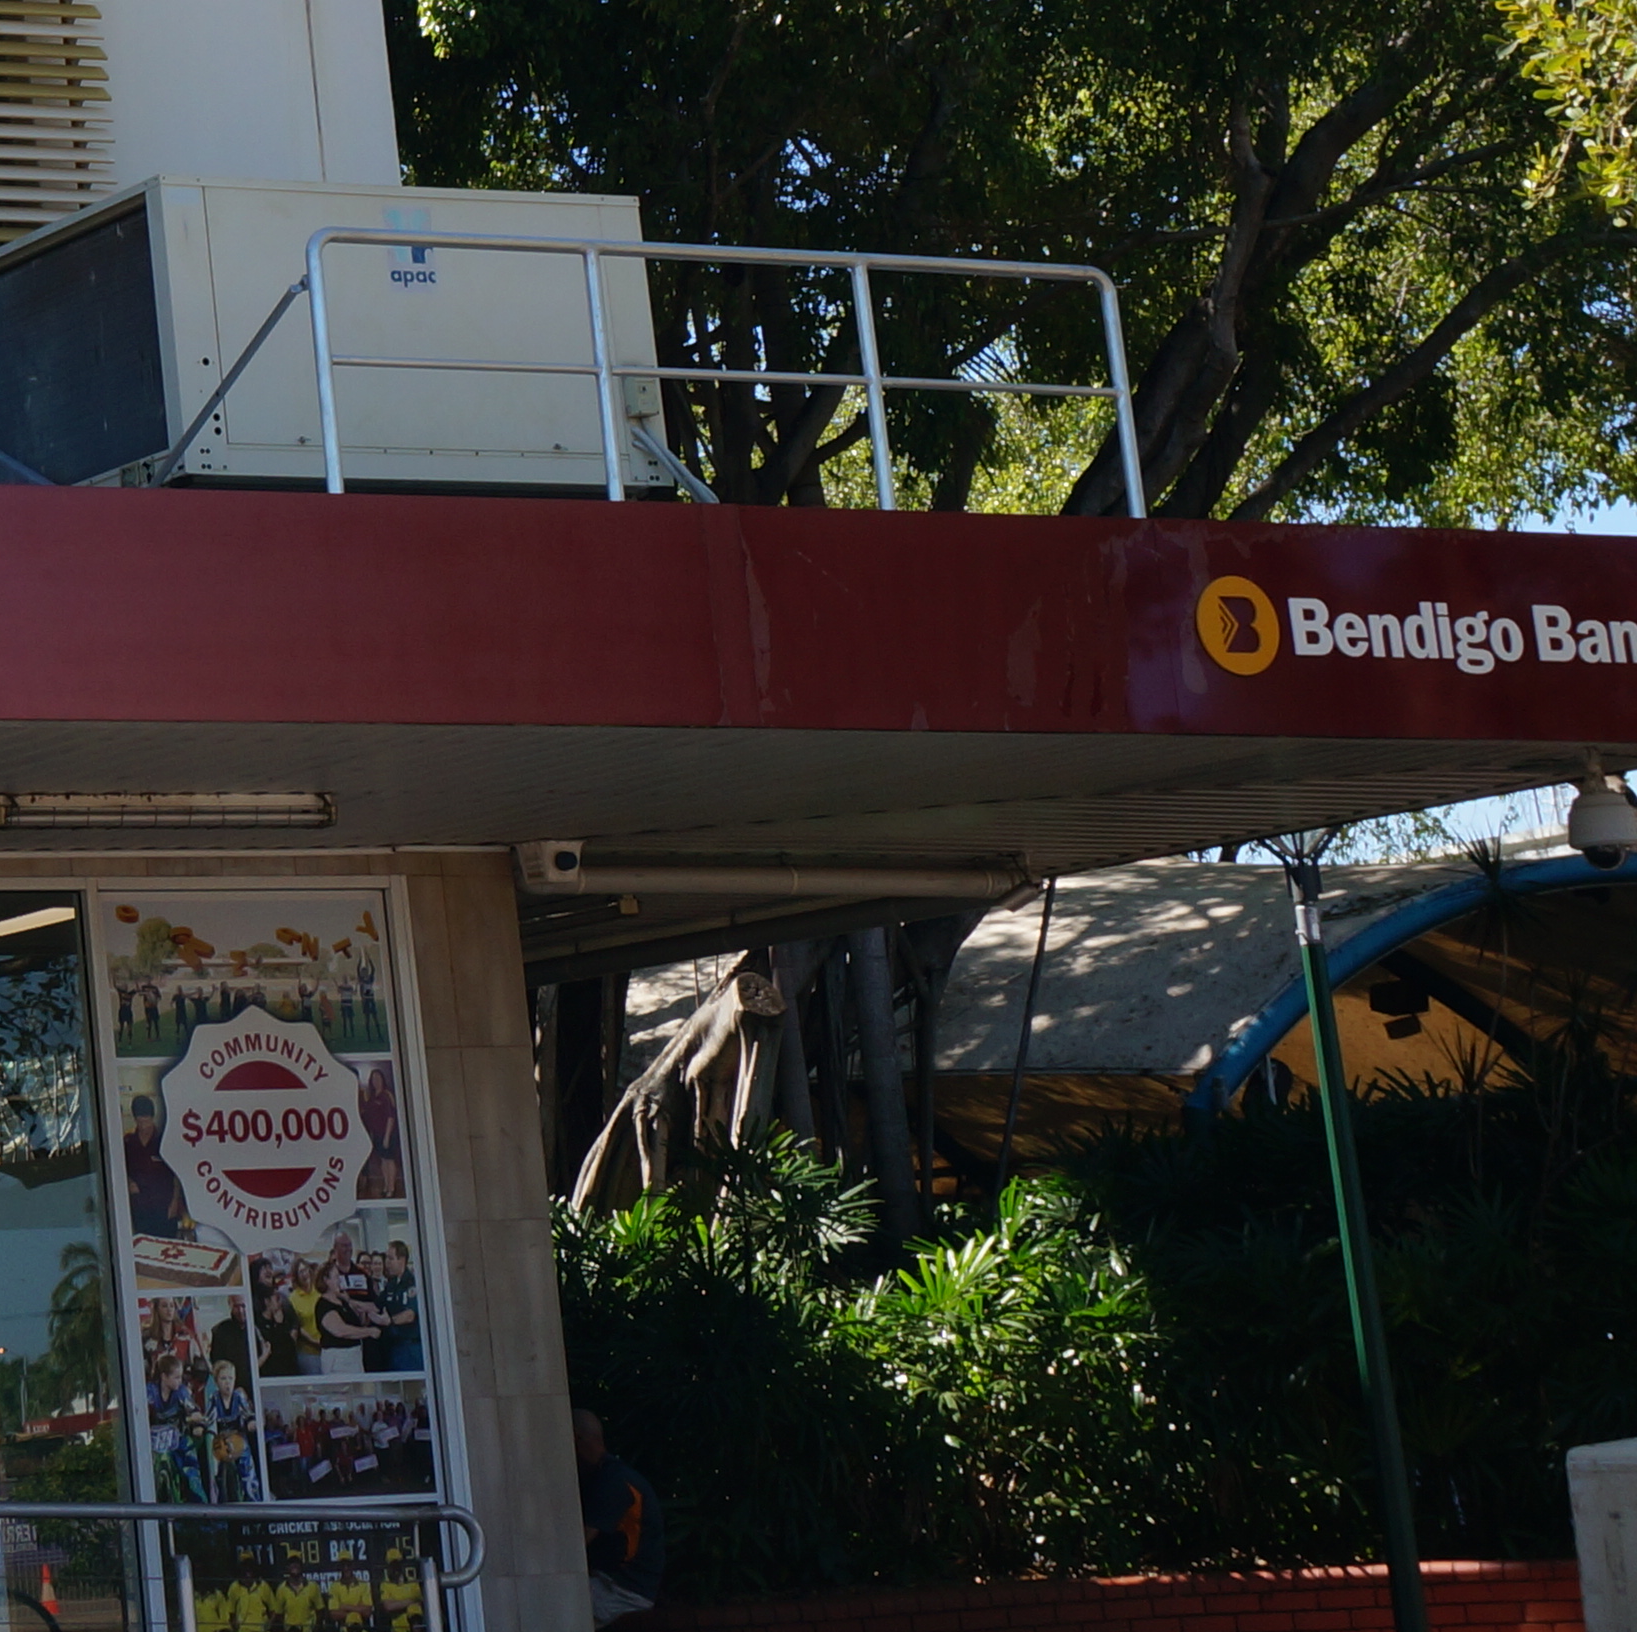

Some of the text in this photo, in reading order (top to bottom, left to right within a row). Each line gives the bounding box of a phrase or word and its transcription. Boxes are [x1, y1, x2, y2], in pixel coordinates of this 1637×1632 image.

[389, 268, 437, 288] apac
[1286, 596, 1637, 675] Bendigo Ban
[198, 1032, 330, 1084] COMMUNITY
[181, 1106, 350, 1149] $400,000
[195, 1154, 345, 1232] CONTRIBUTIONS
[267, 1520, 320, 1536] CRICKET
[357, 1537, 368, 1561] 2
